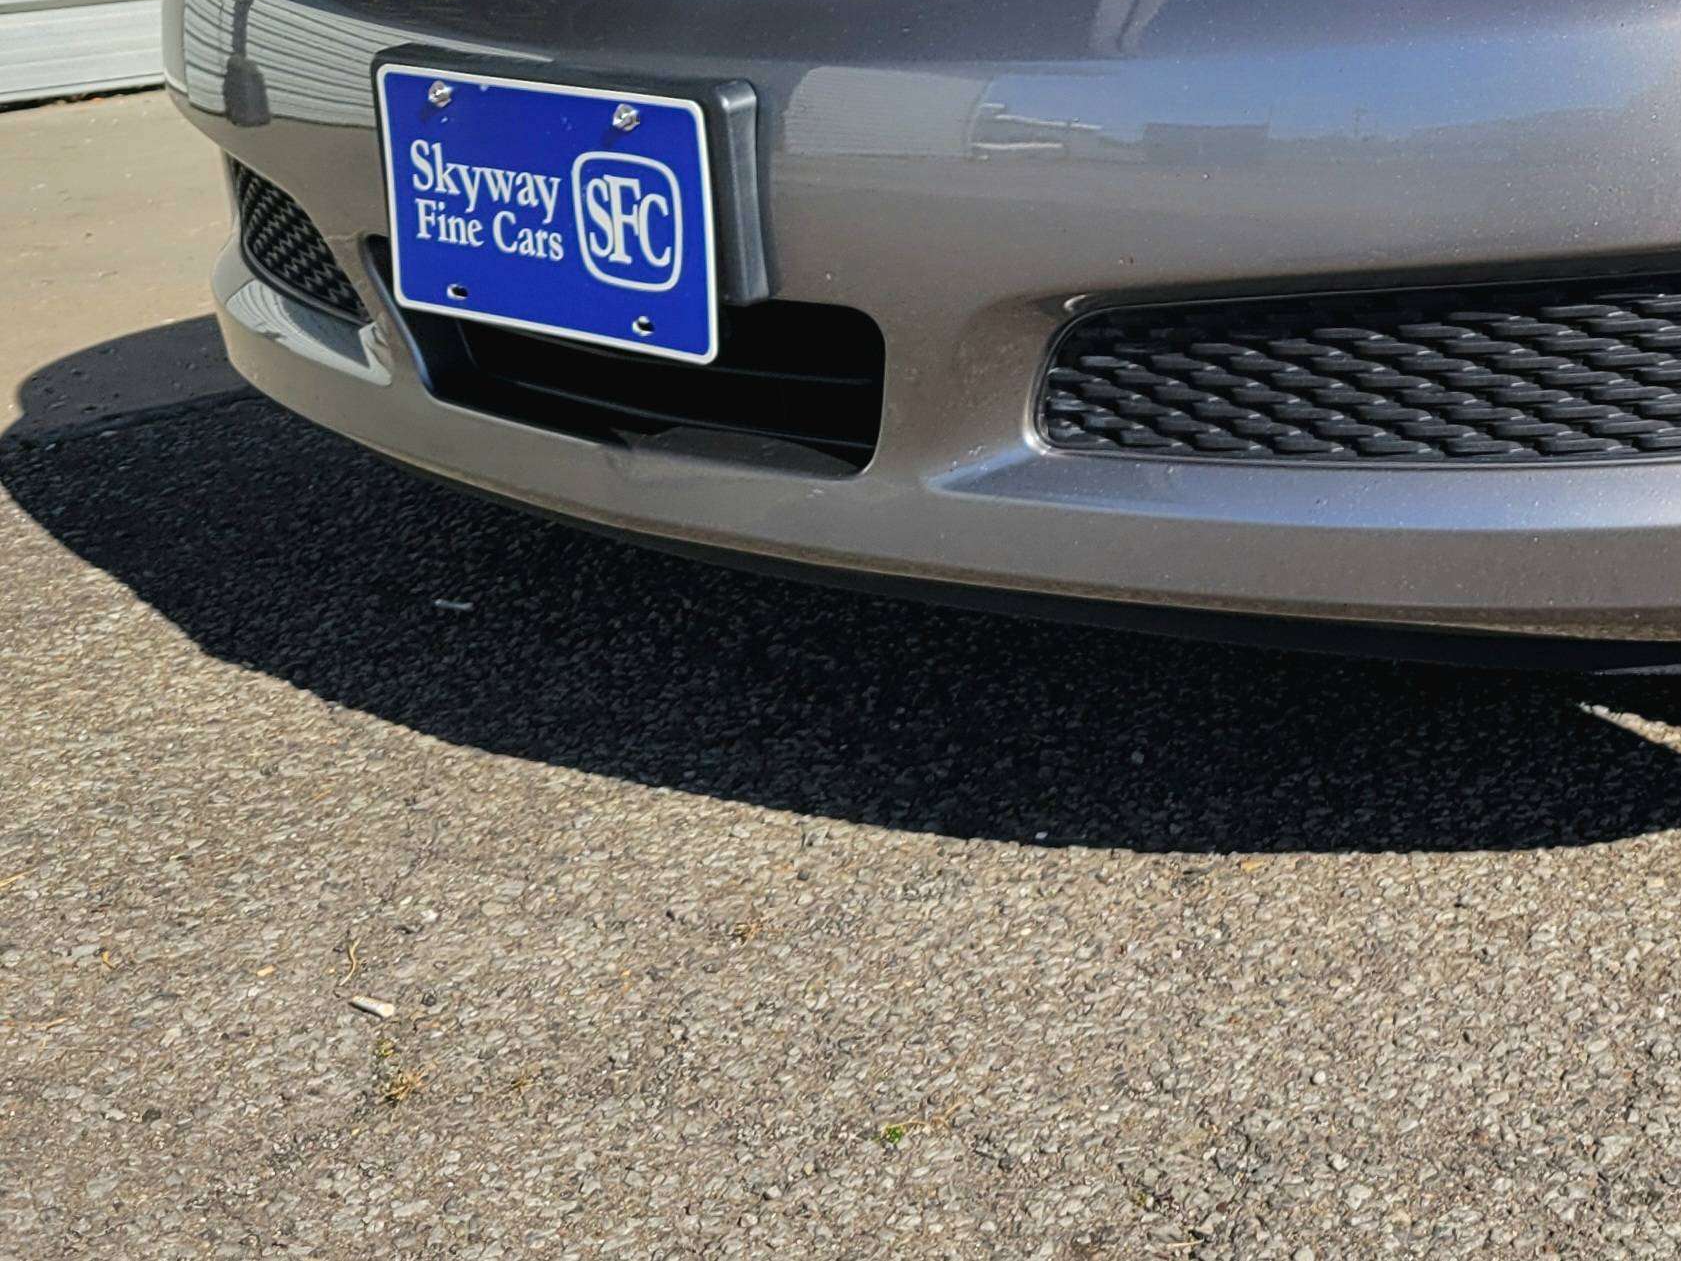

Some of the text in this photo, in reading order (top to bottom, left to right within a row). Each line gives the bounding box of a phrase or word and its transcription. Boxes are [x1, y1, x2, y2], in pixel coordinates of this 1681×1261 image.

[410, 139, 561, 224] Skyway
[586, 174, 673, 268] SFC
[415, 198, 564, 261] Fine Cars
